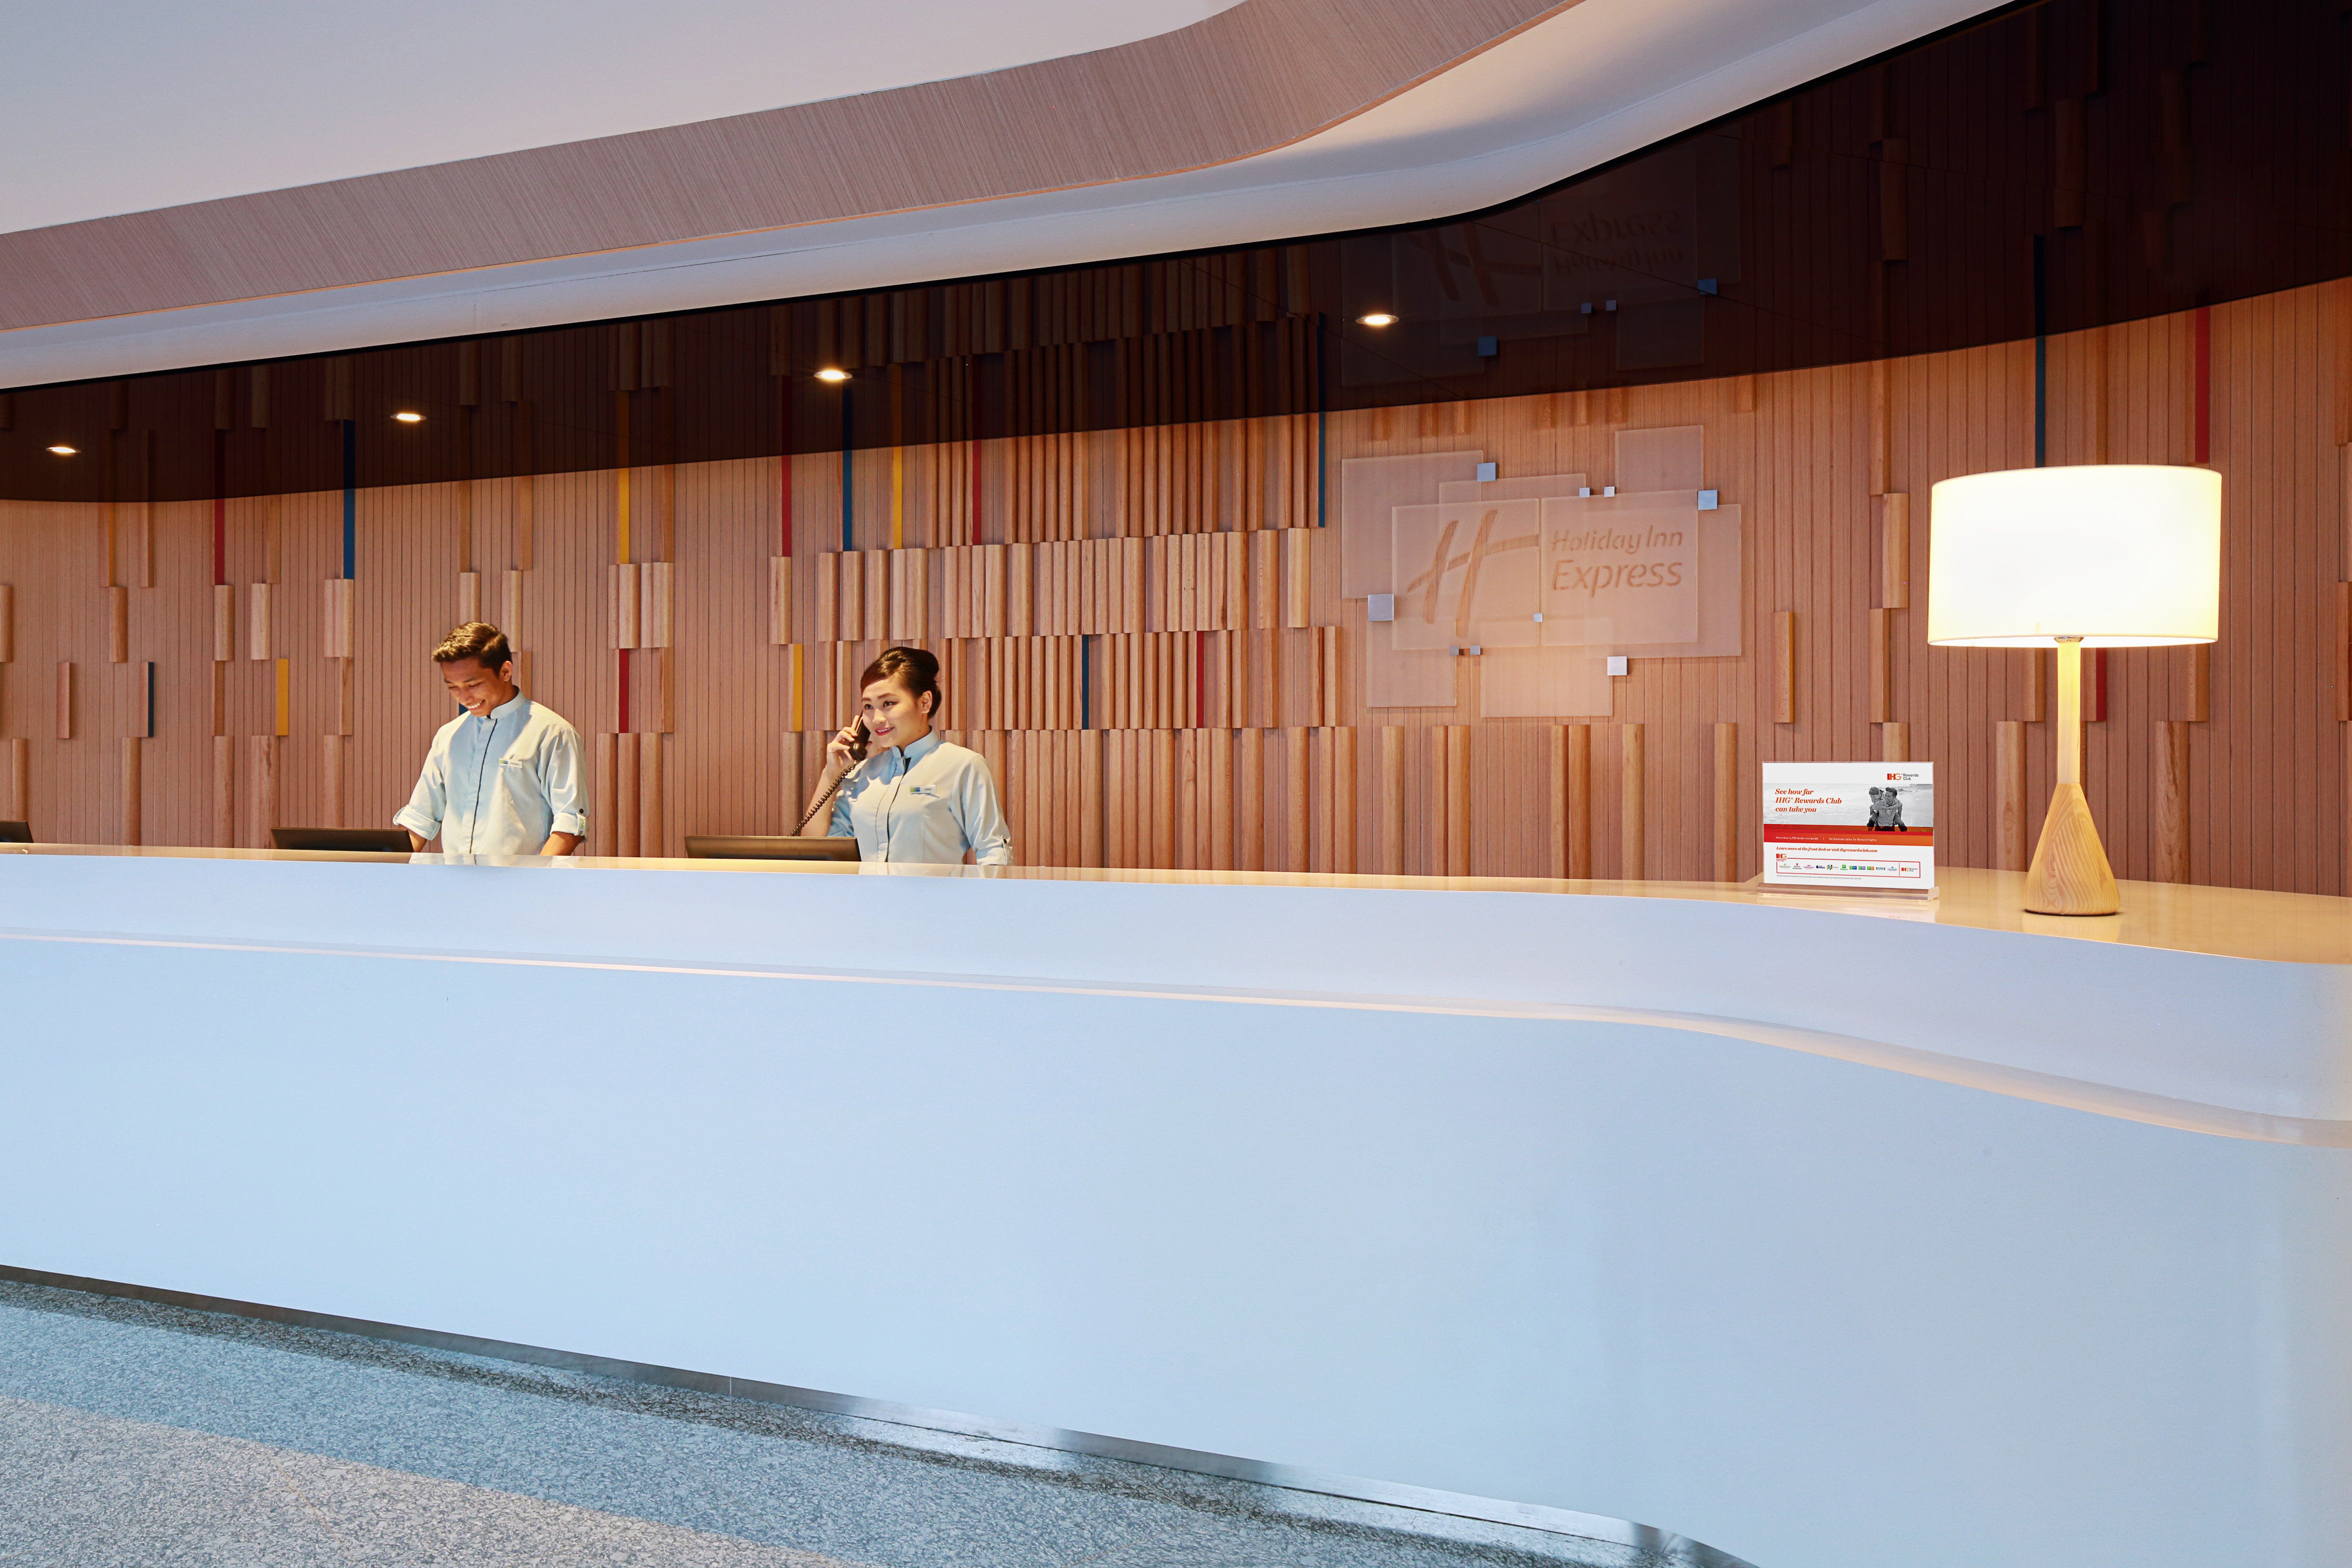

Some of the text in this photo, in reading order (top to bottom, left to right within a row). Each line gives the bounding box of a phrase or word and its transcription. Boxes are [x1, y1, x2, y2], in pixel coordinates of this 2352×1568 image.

[1550, 525, 1683, 555] Holiday Inn
[1552, 559, 1683, 598] Express
